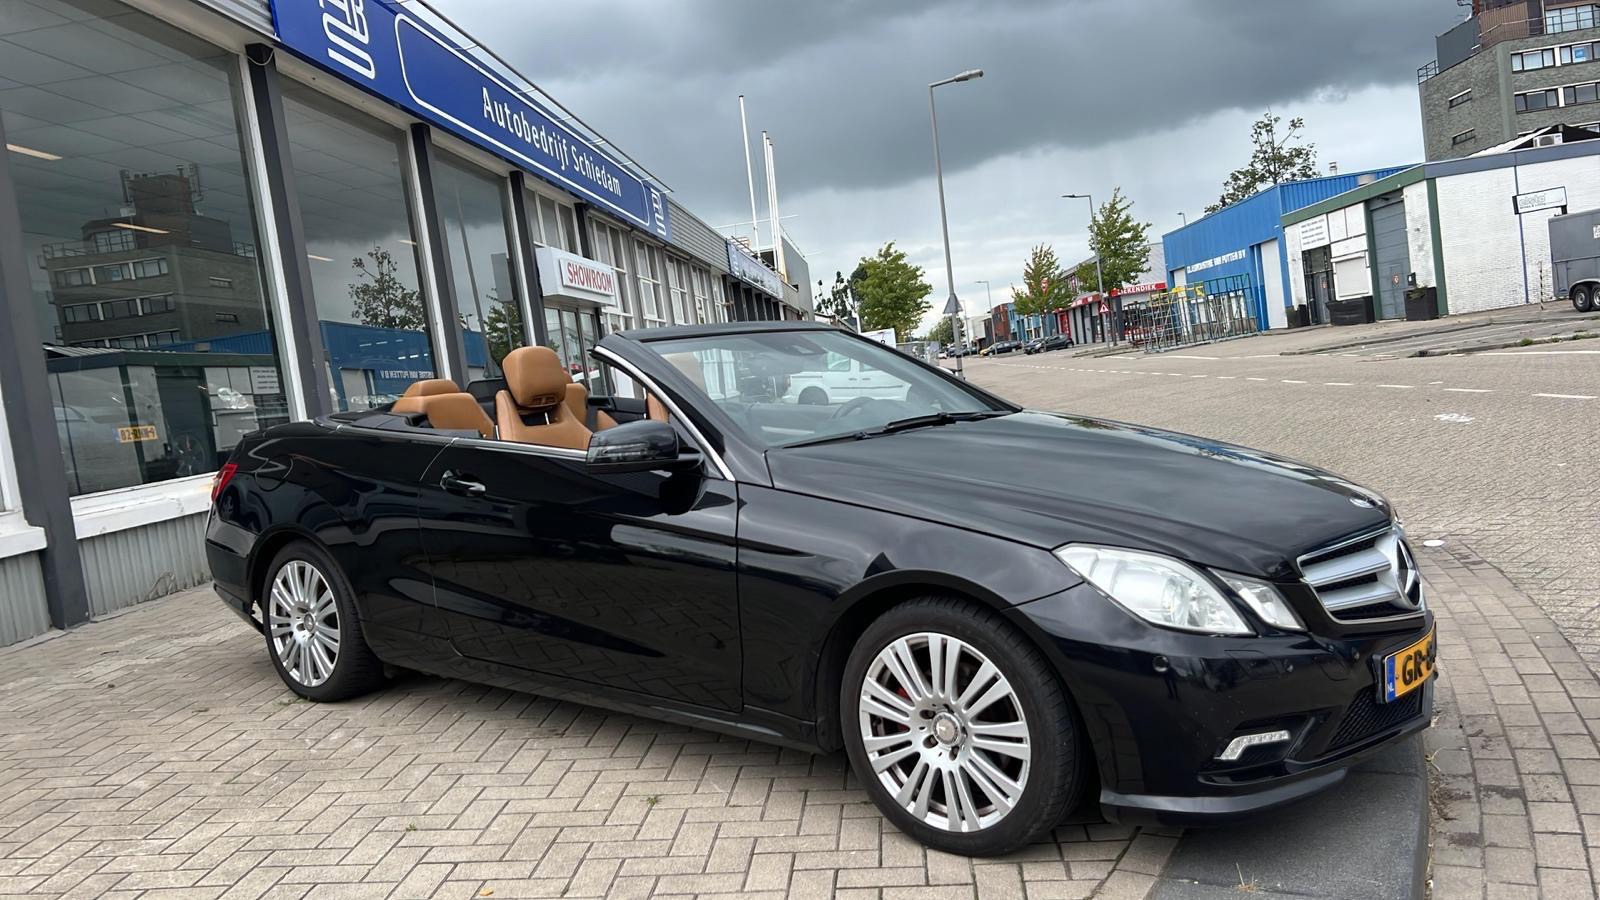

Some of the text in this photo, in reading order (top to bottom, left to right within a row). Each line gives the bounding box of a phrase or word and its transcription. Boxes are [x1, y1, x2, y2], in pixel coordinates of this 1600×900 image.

[482, 87, 622, 197] Autobedrijf Schiedam
[567, 262, 613, 293] SHOWROOM
